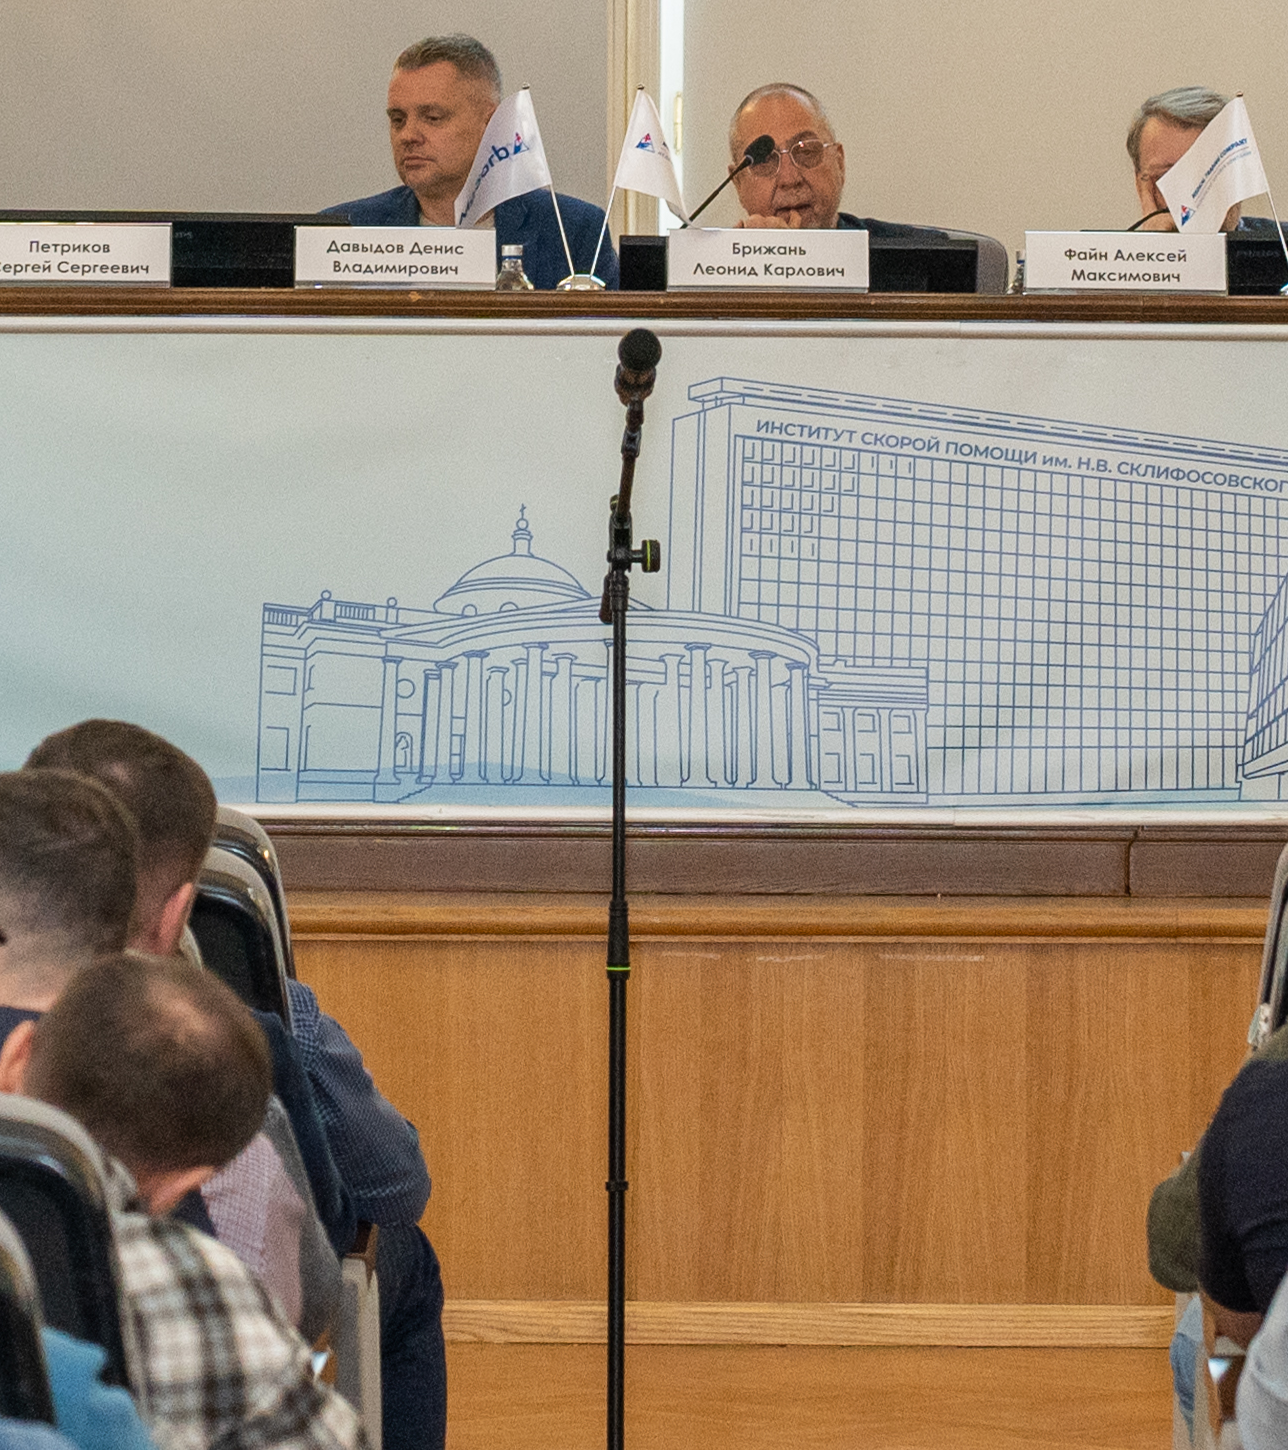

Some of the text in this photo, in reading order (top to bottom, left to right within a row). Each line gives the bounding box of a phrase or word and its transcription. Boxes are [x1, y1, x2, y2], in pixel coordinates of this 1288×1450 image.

[29, 240, 111, 256] Петриков
[325, 239, 464, 256] Давыдов Денис
[732, 242, 807, 258] Брижань
[1063, 247, 1187, 263] Файн Алексей
[56, 260, 150, 277] Сергеевич
[332, 260, 459, 277] Владимирович
[692, 262, 845, 279] Леонид Карлович
[1070, 268, 1181, 283] Максимович
[756, 419, 858, 443] ИНСТИТУТ
[860, 431, 940, 454] СКОРОЙ
[945, 441, 1038, 466] ПОМОЩИ
[1042, 456, 1072, 470] им.
[1077, 457, 1113, 474] Н.В.
